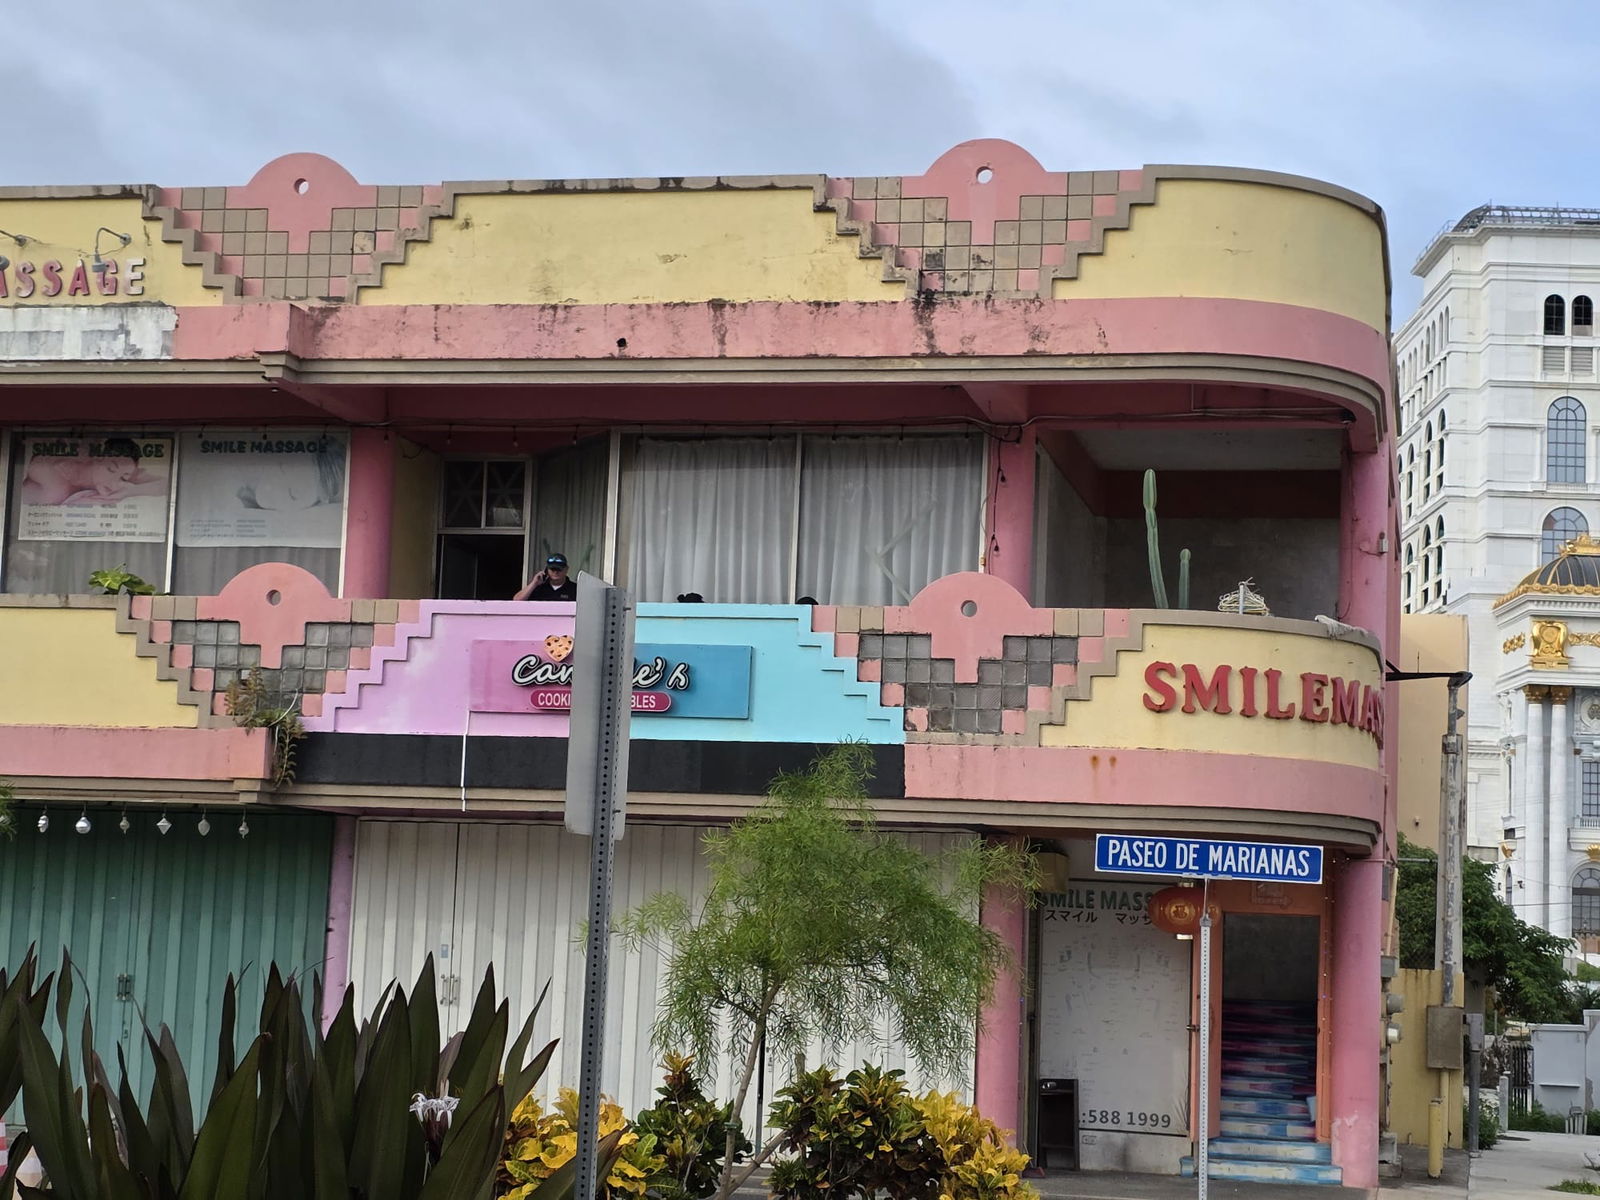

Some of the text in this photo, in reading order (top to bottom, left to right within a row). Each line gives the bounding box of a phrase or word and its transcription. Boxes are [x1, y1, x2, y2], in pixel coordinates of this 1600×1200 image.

[31, 442, 79, 457] SMILE
[200, 440, 328, 454] SMILE MASSAGE
[1107, 839, 1310, 877] PASEO DE MARIANAS
[1045, 909, 1098, 923] スマイル
[1078, 1109, 1171, 1128] :588 1999
